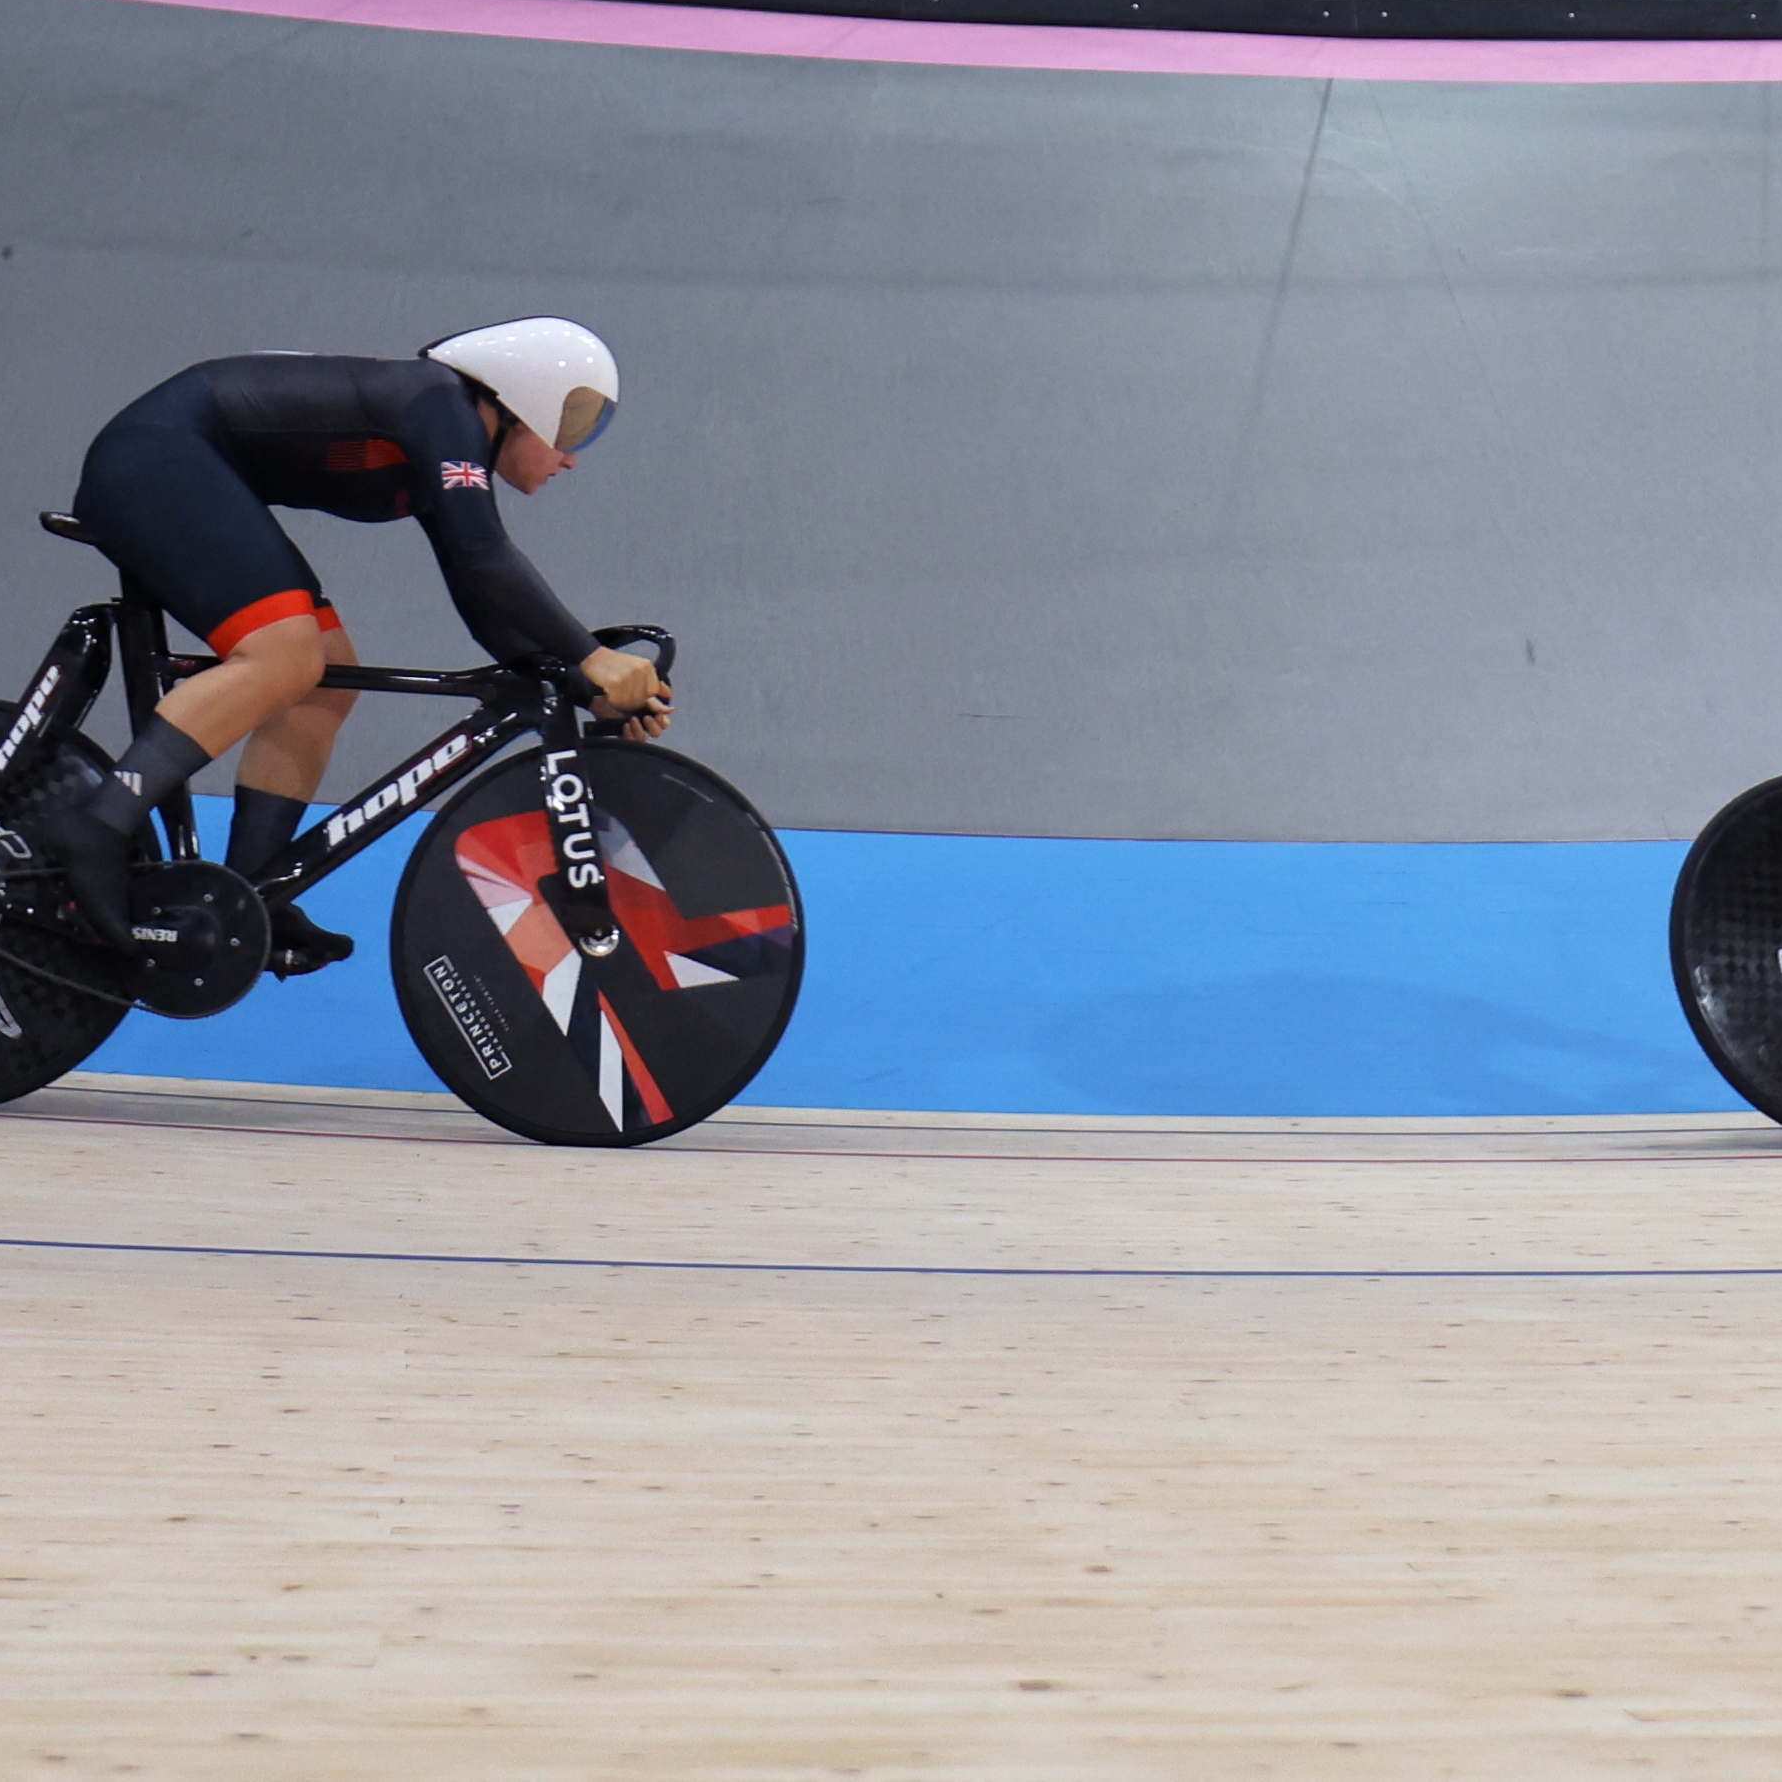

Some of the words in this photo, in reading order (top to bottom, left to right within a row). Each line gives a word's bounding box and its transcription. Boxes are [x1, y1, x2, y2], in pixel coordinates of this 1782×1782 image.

[326, 733, 469, 848] hope
[546, 749, 600, 889] LOTUS
[432, 965, 503, 1070] PRINCETON
